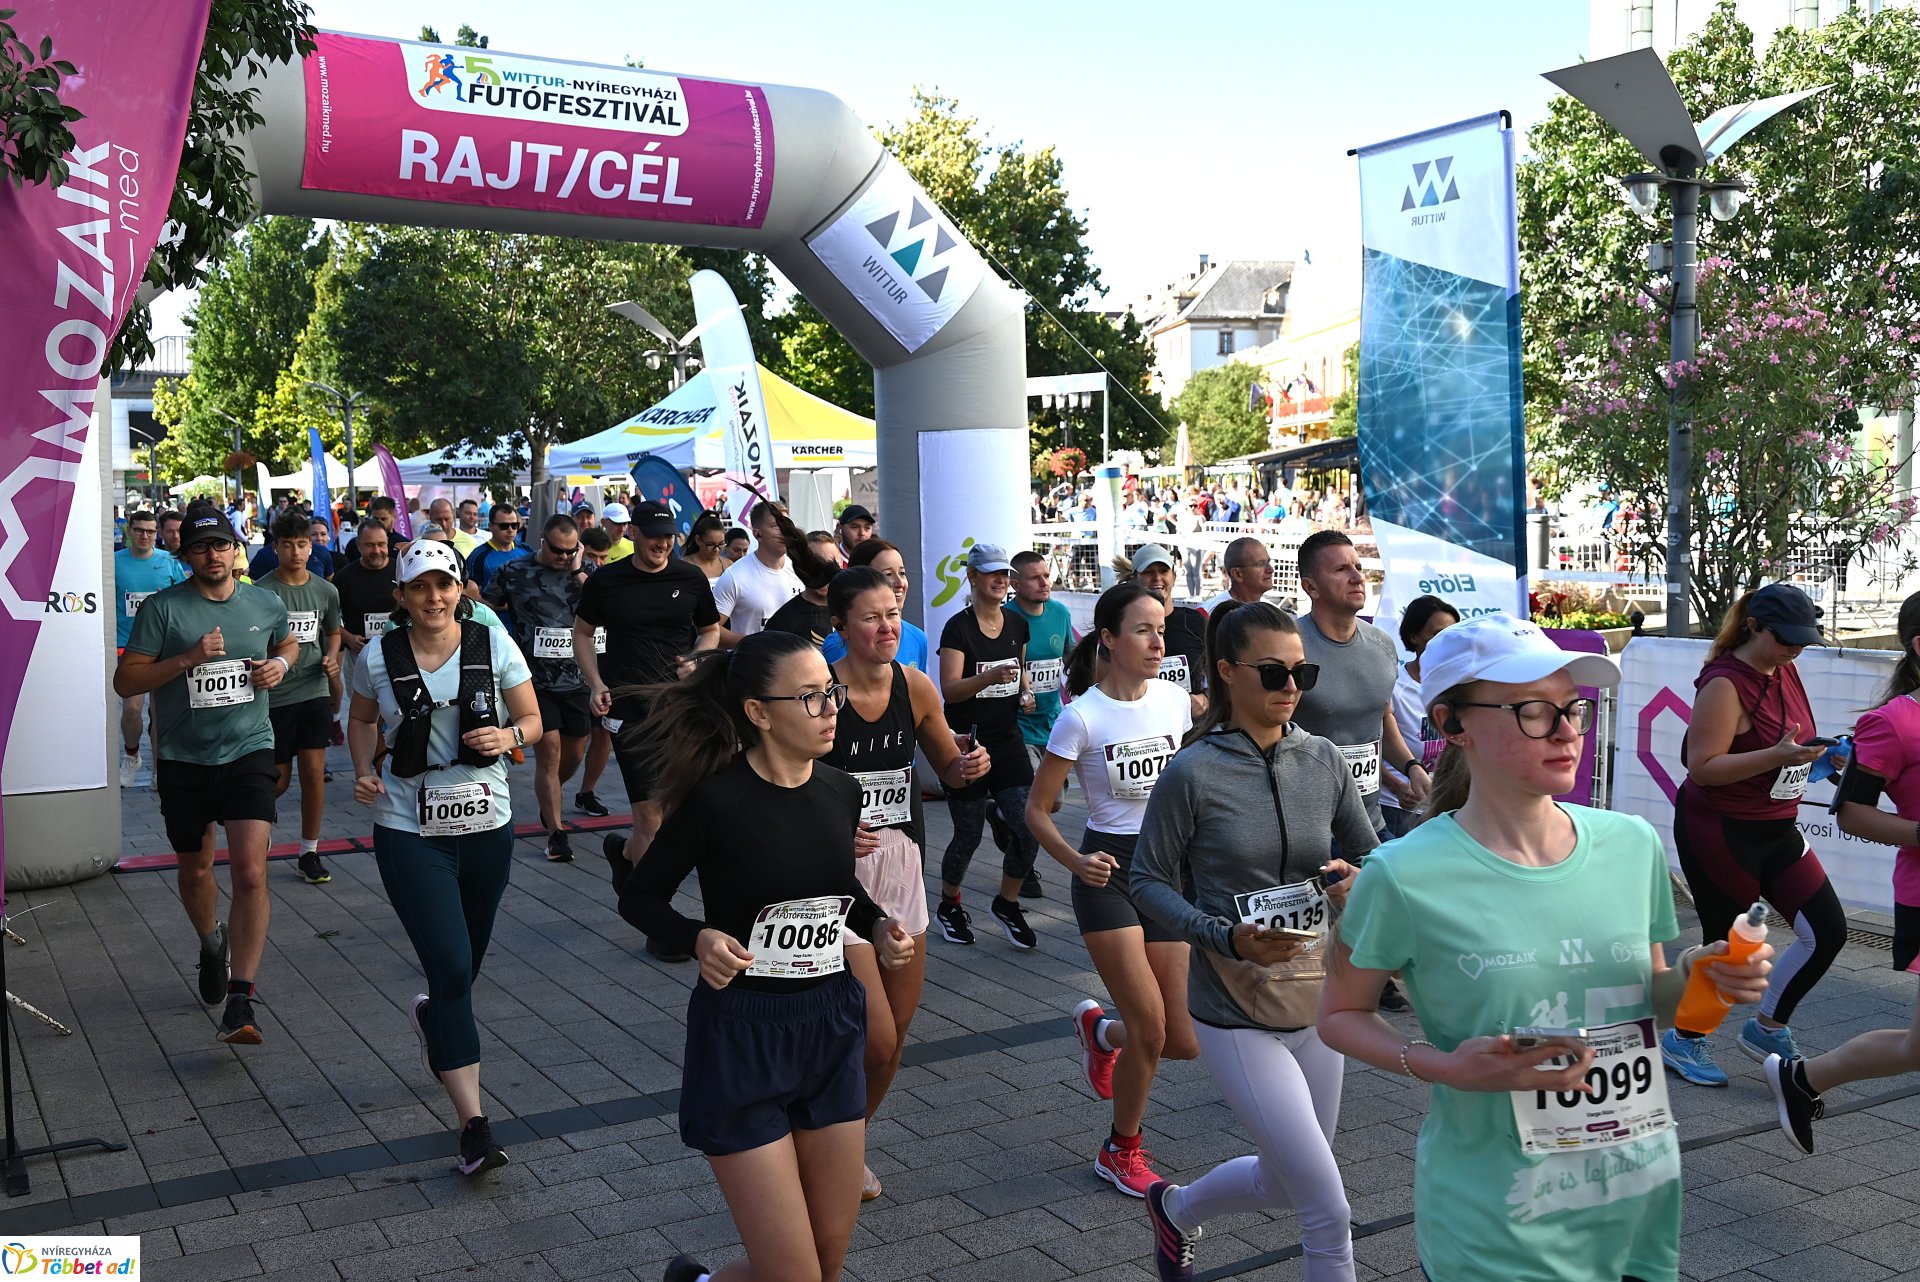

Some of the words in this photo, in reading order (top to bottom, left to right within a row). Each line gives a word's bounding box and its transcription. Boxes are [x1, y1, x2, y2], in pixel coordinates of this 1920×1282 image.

[502, 70, 678, 101] WITTUR-NYÍREGYHÁZI
[319, 56, 332, 153] www.mozaikmed.hu
[468, 84, 682, 127] FUTÓFESZTIVÁL
[400, 128, 693, 206] RAJT/CÉL
[113, 144, 140, 235] med
[862, 255, 909, 305] WITTUR
[31, 141, 115, 455] MOZAIK
[634, 406, 717, 426] KÄRCHER
[791, 446, 843, 455] KÄRCHER
[45, 591, 97, 614] ROS
[289, 621, 316, 632] 0137
[539, 638, 572, 648] 10023
[195, 673, 248, 693] 10019
[850, 730, 903, 756] NIKE
[425, 798, 489, 820] 10063
[862, 786, 907, 809] 0108
[763, 919, 840, 950] 10086
[1485, 952, 1537, 967] MOZAIK
